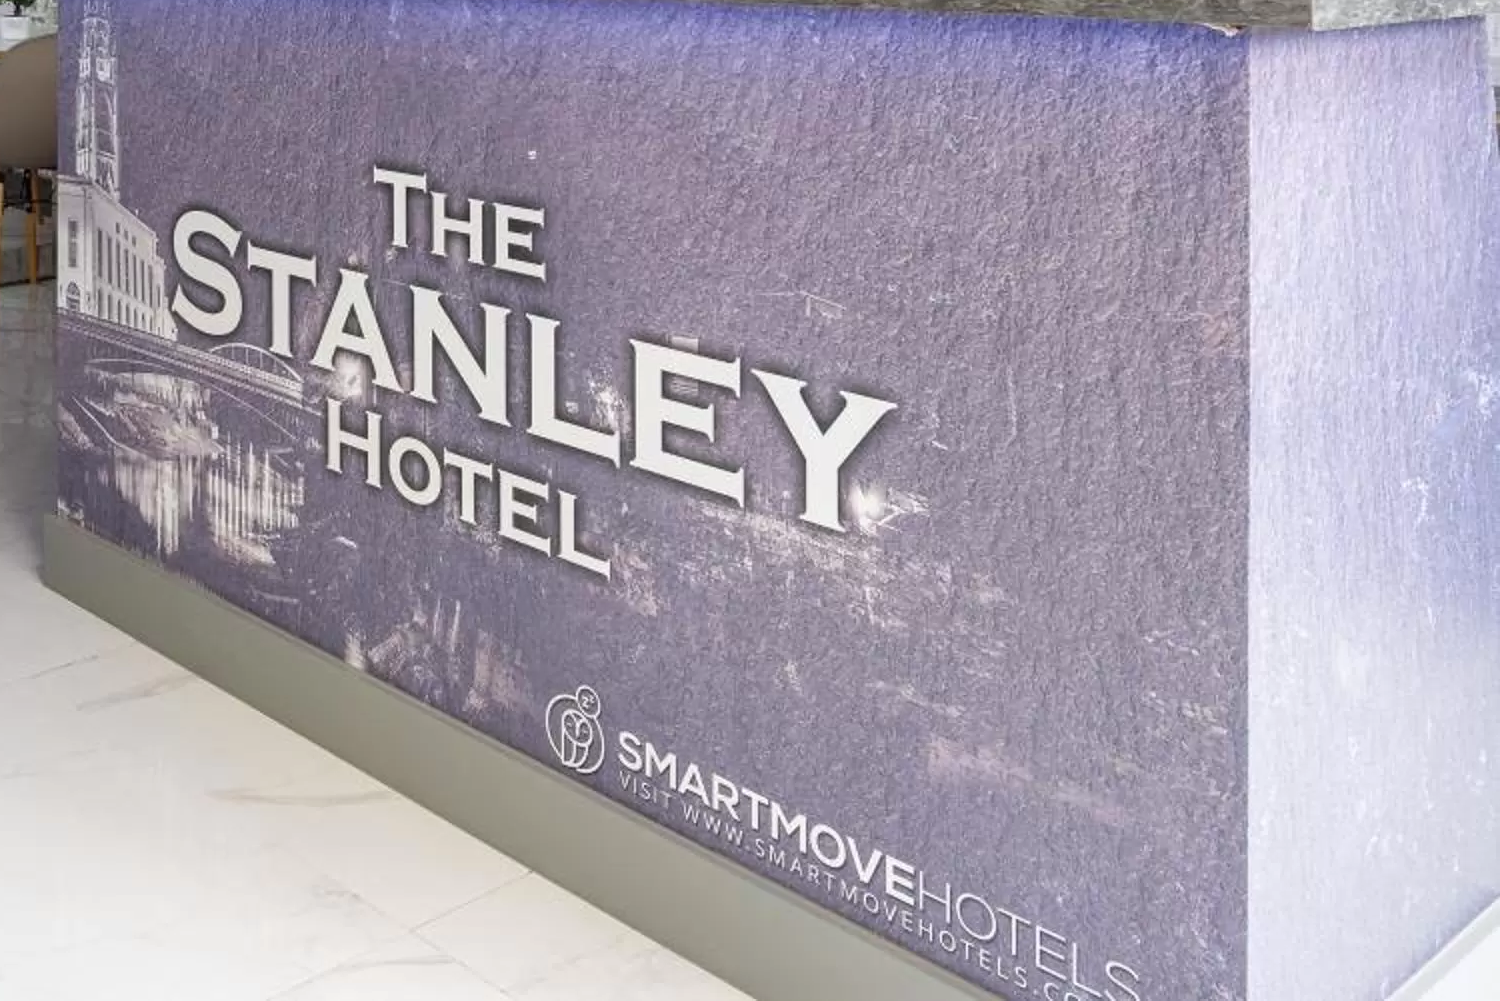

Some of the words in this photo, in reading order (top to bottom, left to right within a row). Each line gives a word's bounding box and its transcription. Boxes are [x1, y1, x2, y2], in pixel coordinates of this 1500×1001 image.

[372, 165, 547, 281] THE
[171, 209, 898, 533] STANLEY
[325, 398, 612, 581] HOTEL
[618, 730, 1140, 1001] SMARTMOVEHOTELS
[619, 770, 673, 809] VISIT
